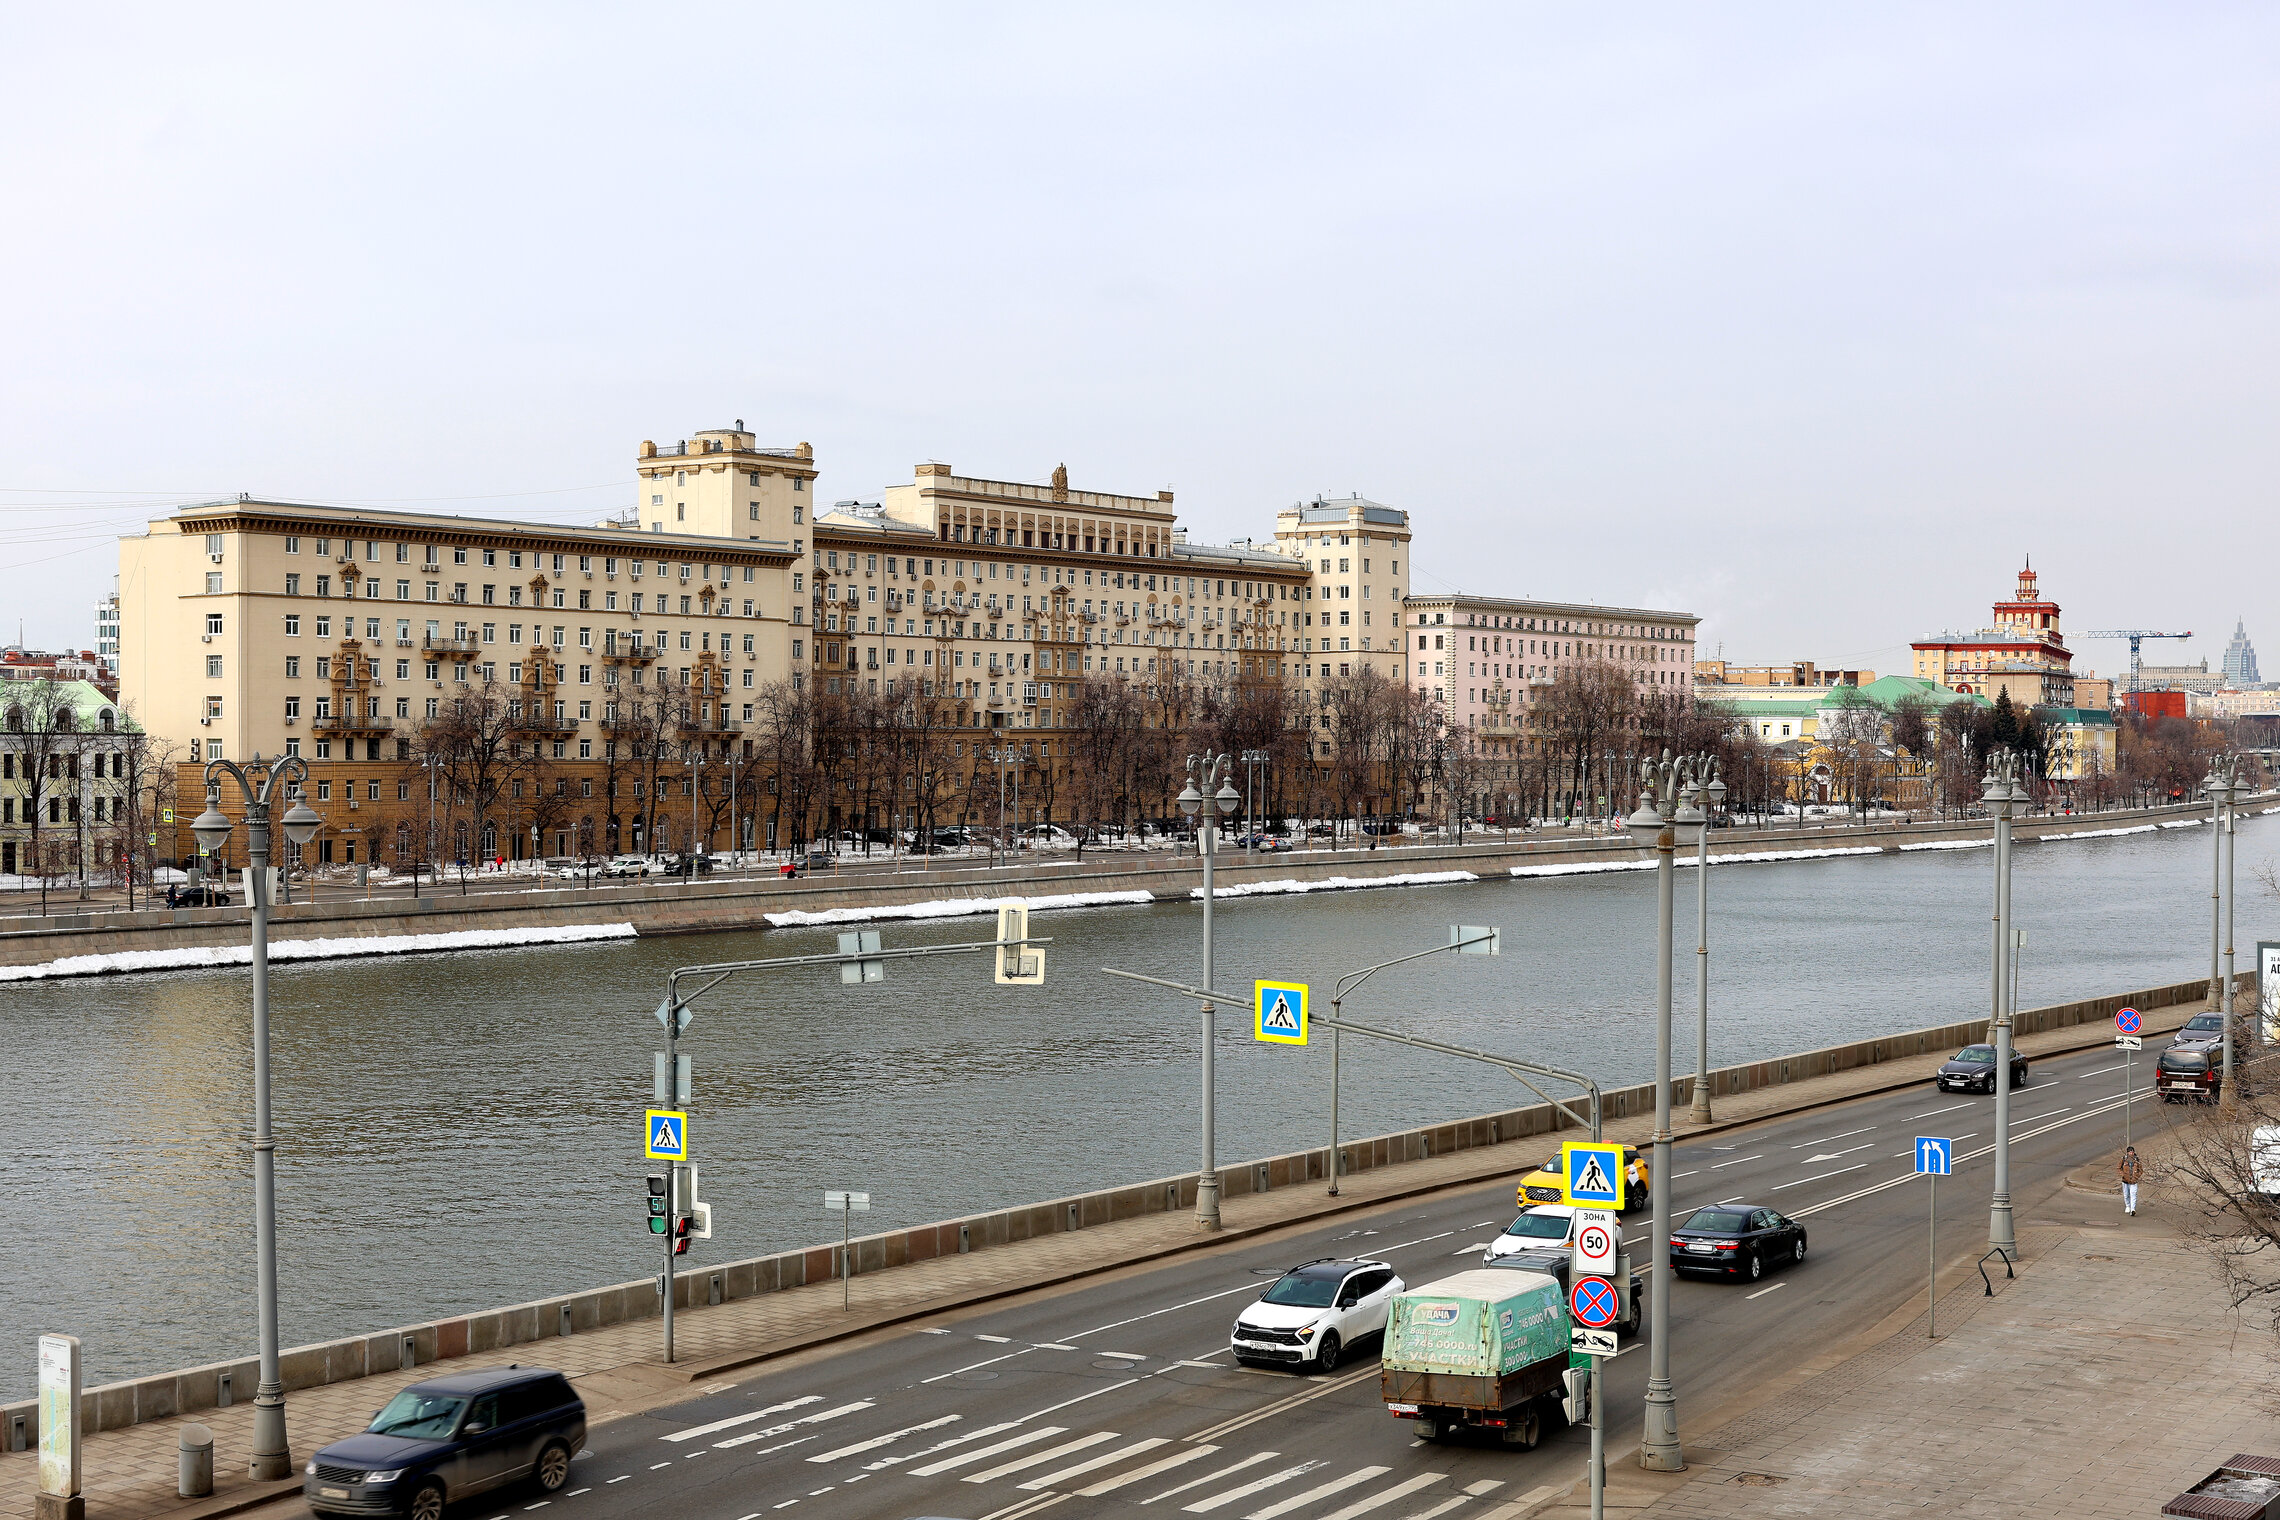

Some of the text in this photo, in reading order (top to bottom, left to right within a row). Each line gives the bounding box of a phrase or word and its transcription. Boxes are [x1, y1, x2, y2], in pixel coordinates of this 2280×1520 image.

[652, 1198, 665, 1210] 57
[1583, 1212, 1606, 1221] ЗОНА
[1586, 1236, 1603, 1249] 50
[1420, 1309, 1451, 1320] УДАЧА
[1436, 1339, 1478, 1351] 0000.ru
[1503, 1335, 1528, 1353] УЧАСТКИ
[1408, 1351, 1478, 1366] УЧАСТКИ
